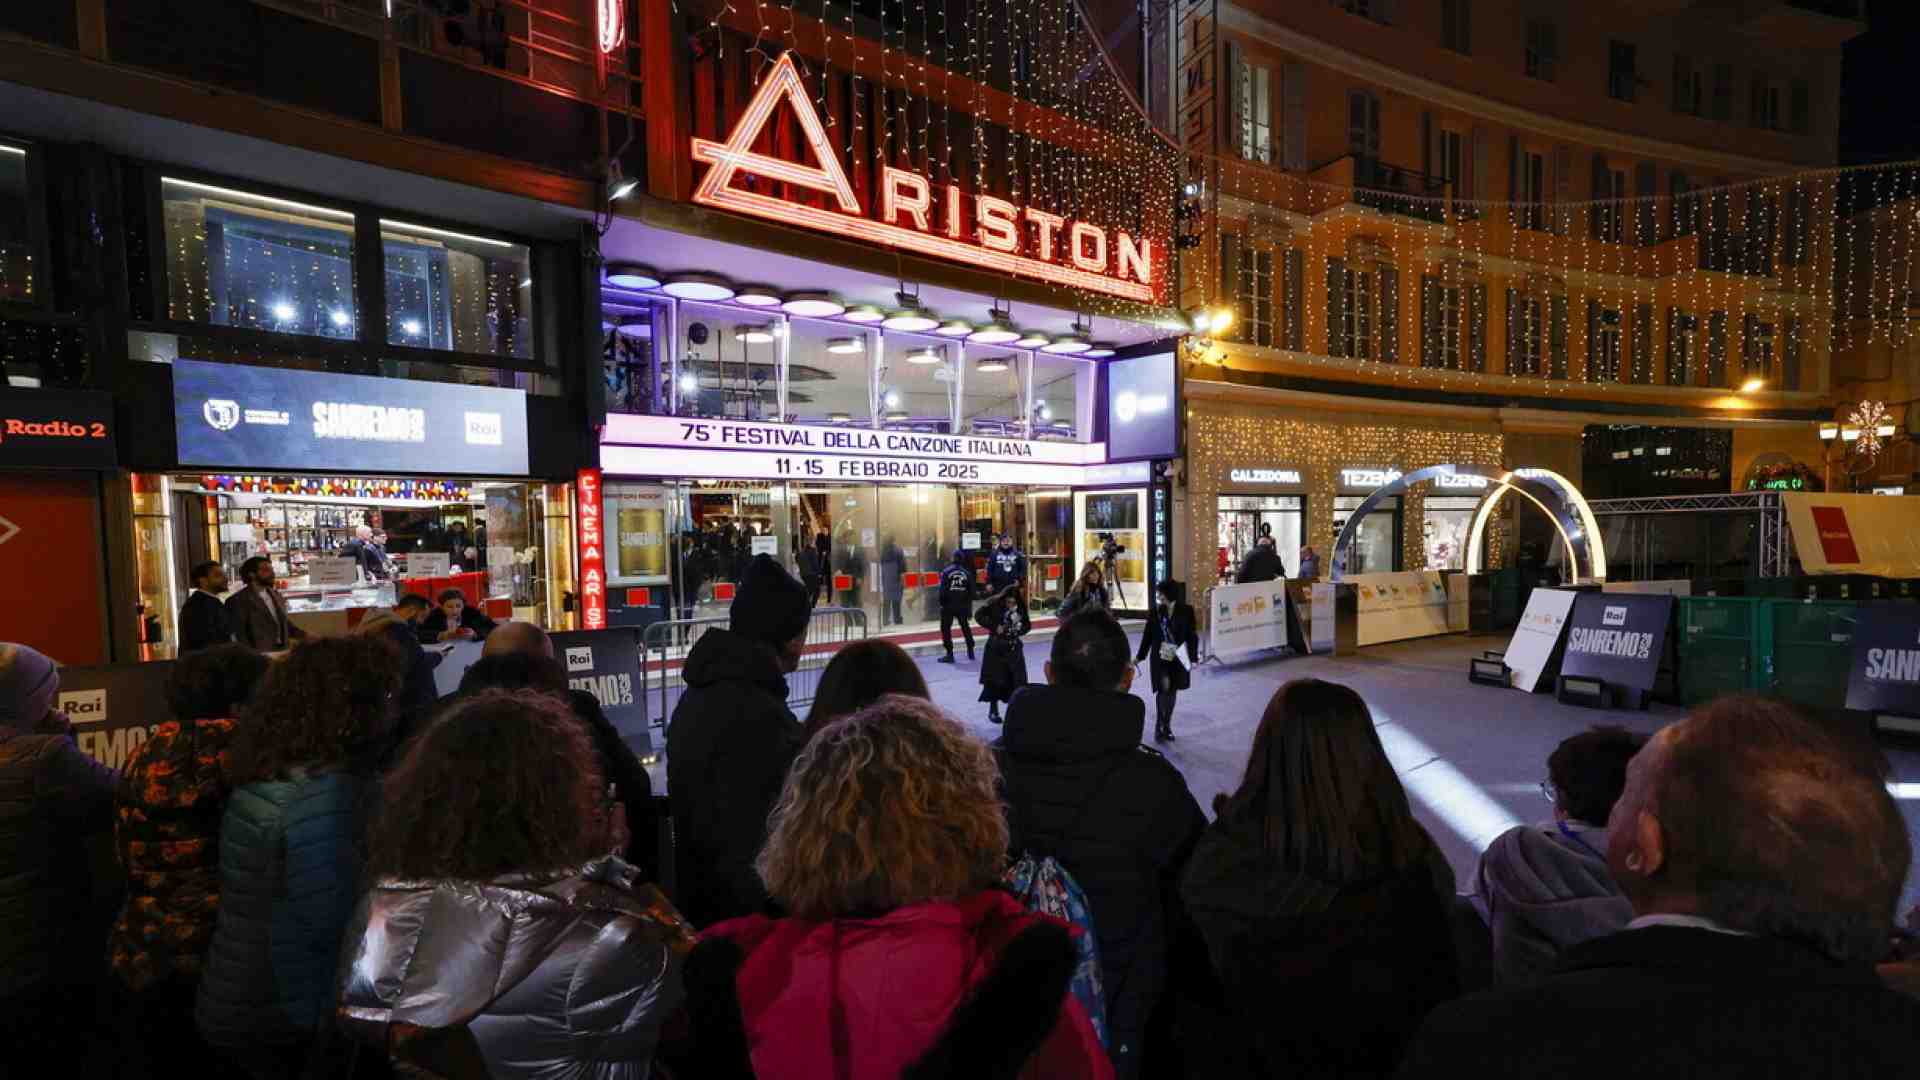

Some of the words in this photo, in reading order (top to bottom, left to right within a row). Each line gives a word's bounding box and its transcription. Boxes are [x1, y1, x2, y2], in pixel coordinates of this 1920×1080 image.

[691, 53, 1151, 284] ARISTON
[5, 419, 86, 437] Radio
[91, 422, 106, 438] 2
[470, 421, 497, 434] Rai
[722, 426, 816, 446] FESTIVAL
[824, 431, 880, 449] DELLA
[887, 435, 962, 454] CANZONE
[968, 440, 1032, 457] ITALIANA
[838, 461, 928, 478] FEBBRAIO
[938, 463, 979, 480] 2025
[1230, 469, 1301, 483] CALZEDONIA
[581, 476, 600, 558] CINEMA
[1155, 489, 1166, 557] CINEMA
[1606, 610, 1624, 621] Rai
[1568, 627, 1639, 659] SANREMO
[569, 652, 590, 664] Rai
[64, 698, 102, 714] Rai
